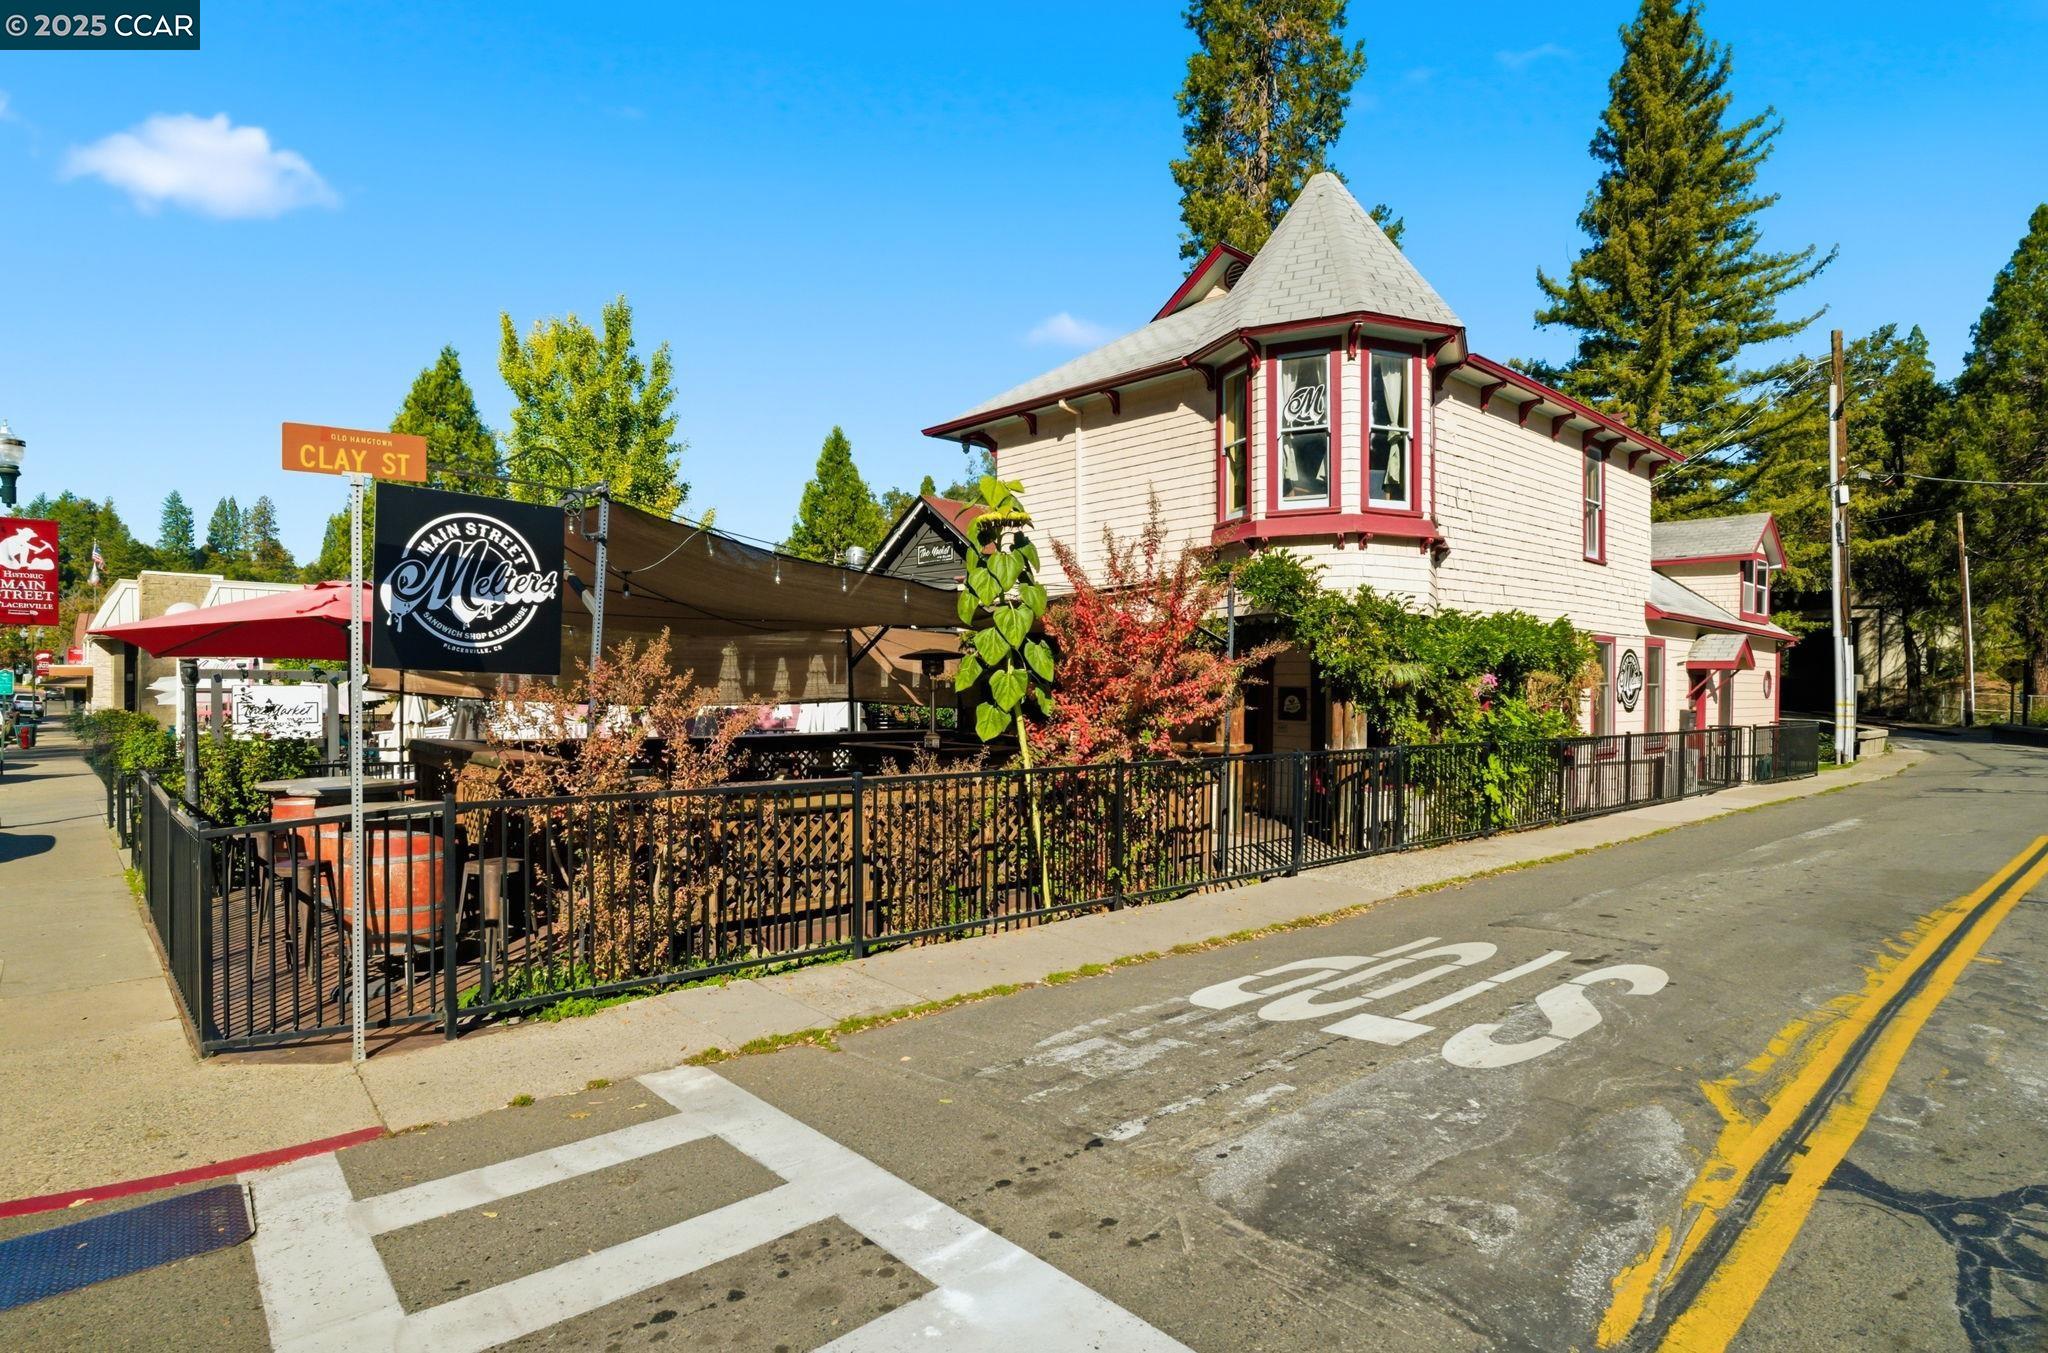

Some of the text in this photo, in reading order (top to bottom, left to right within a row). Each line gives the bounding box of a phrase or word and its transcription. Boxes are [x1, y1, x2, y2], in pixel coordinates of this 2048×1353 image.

[330, 433, 393, 447] OLD HANGTOWN
[300, 444, 411, 476] CLAY ST
[417, 522, 528, 567] MAIN STREET
[0, 579, 46, 590] MAIN
[388, 538, 558, 612] Melters
[0, 589, 55, 601] TREET
[423, 611, 463, 639] SANDWICH
[464, 632, 487, 641] SHOP
[493, 625, 509, 636] TAP
